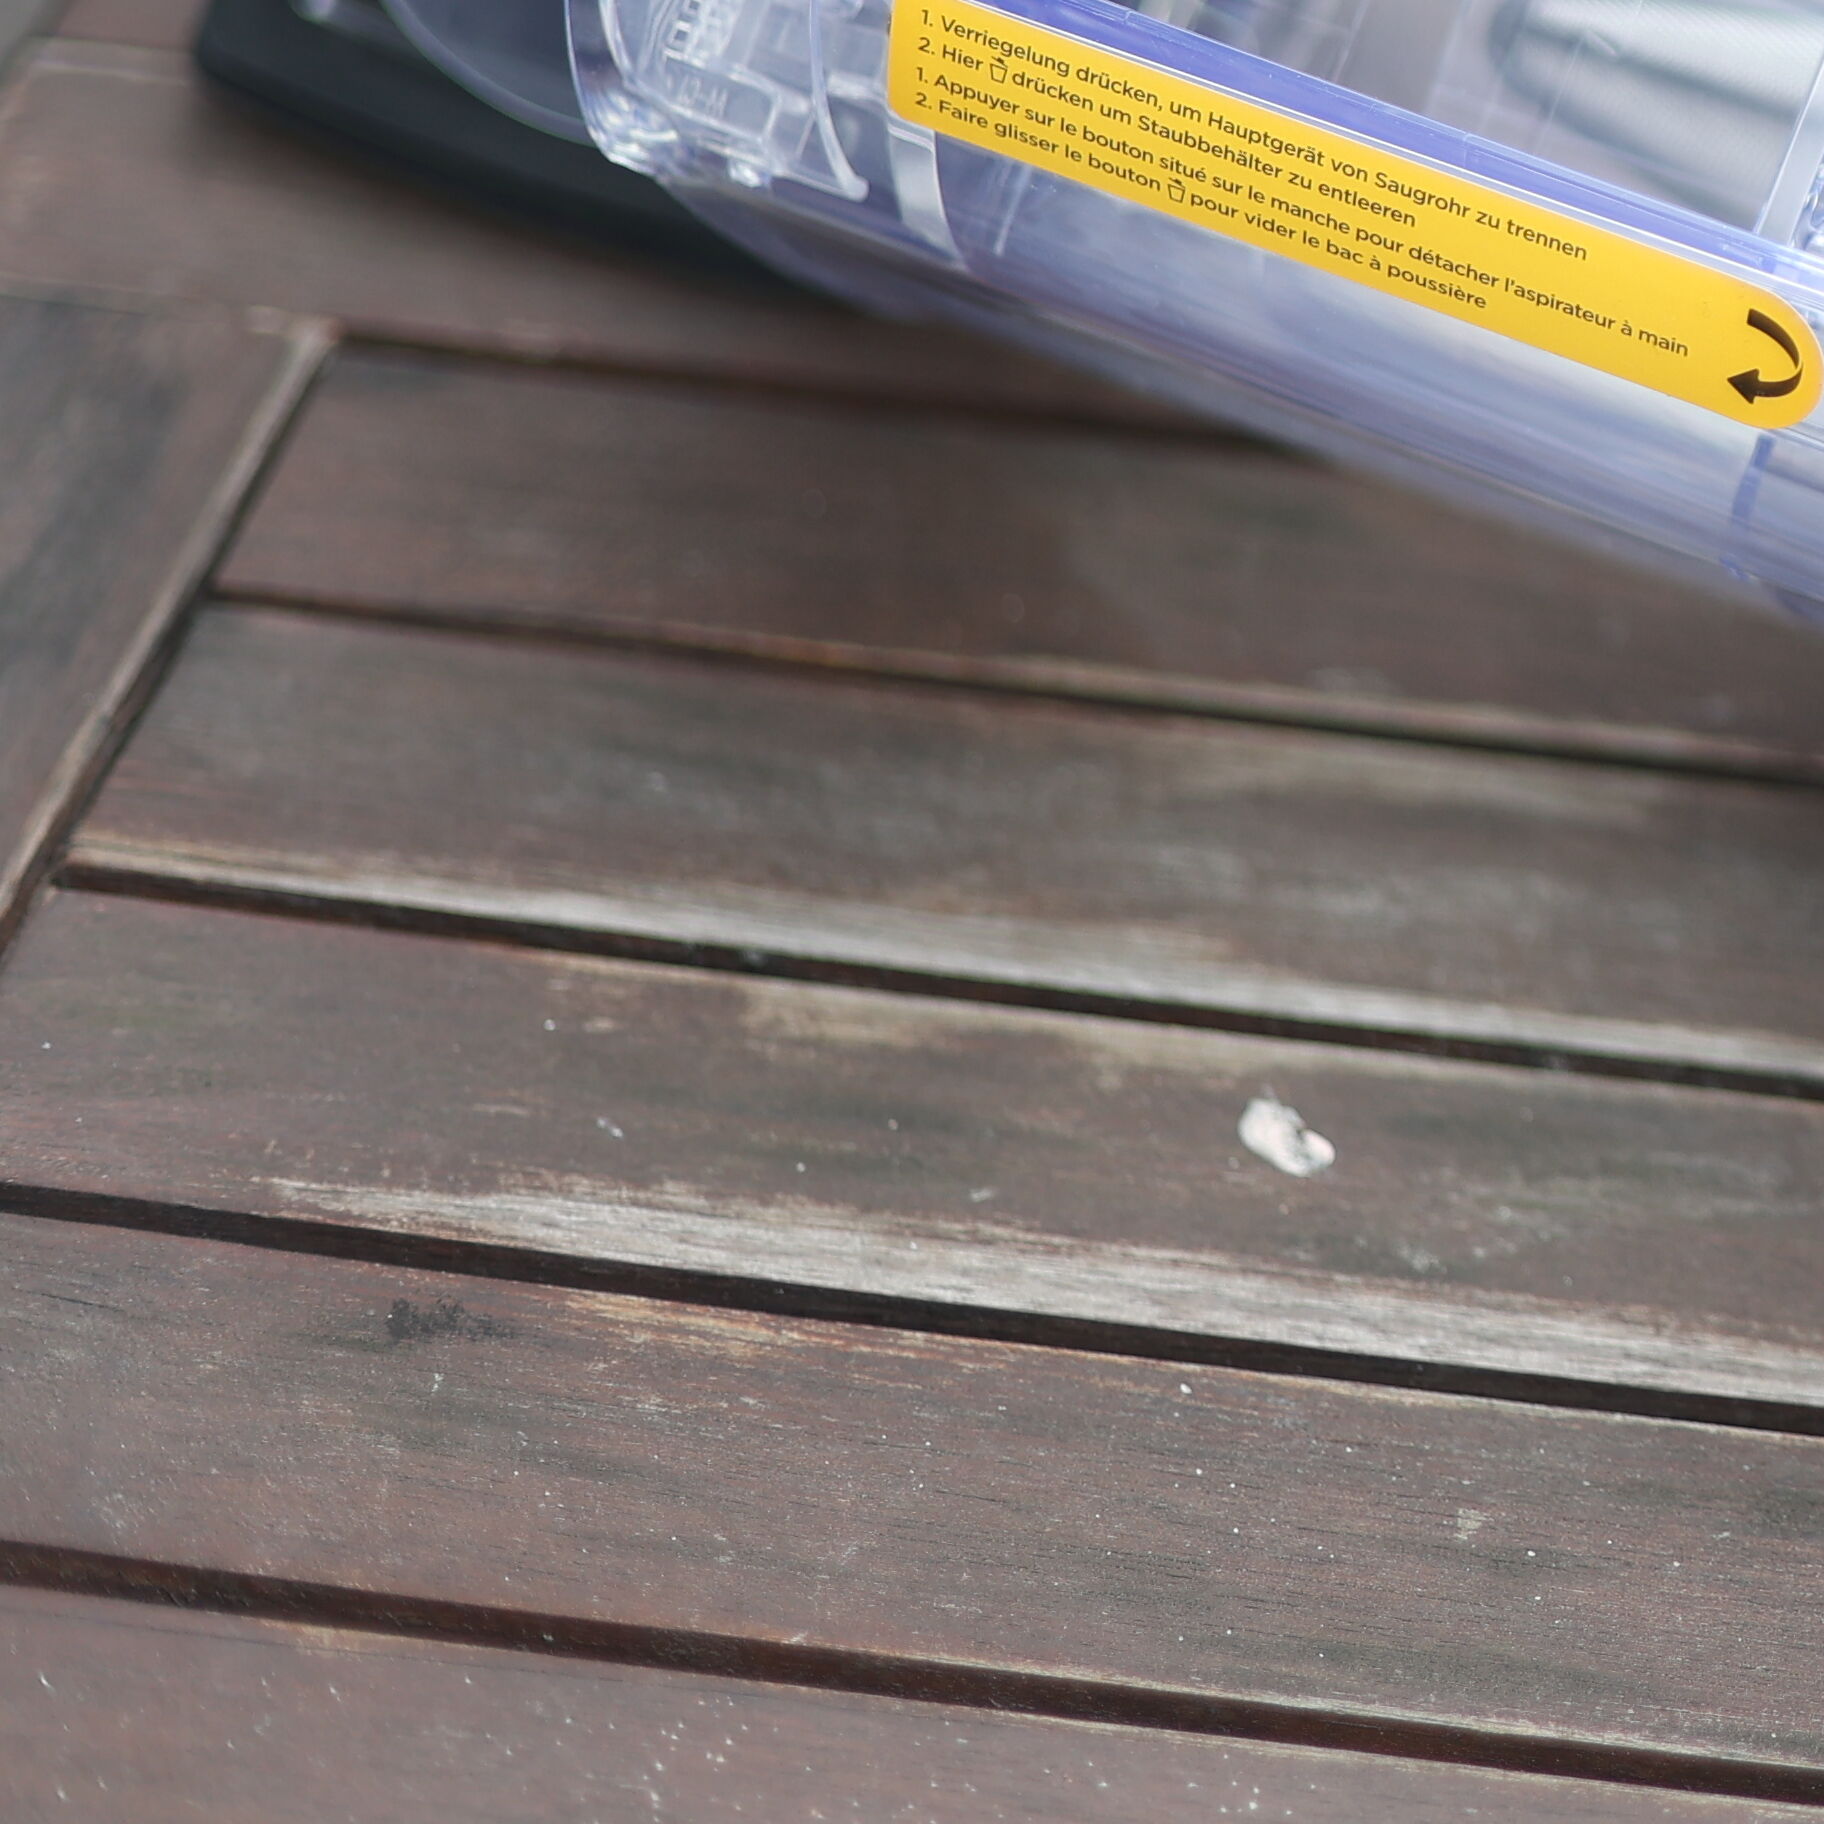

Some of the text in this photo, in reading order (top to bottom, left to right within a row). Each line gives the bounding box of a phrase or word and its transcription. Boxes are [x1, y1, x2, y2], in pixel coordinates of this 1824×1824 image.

[915, 92, 1487, 309] 2. Faire glisser le bouton pour vider le bac à poussière
[916, 66, 928, 84] 1.
[933, 74, 1021, 115] Appuyer
[1024, 108, 1056, 127] sur
[1060, 117, 1078, 136] le
[1082, 125, 1154, 164] bouton
[1159, 156, 1207, 183] situé
[1212, 176, 1244, 195] sur
[1248, 185, 1266, 204] le
[1270, 197, 1351, 235] manche
[1355, 227, 1404, 253] pour
[1408, 246, 1500, 288] détacher
[1620, 320, 1633, 337] à
[1638, 330, 1688, 357] main
[918, 36, 1416, 227] 2. Hier drücken um Staubbehälter zu entleeren
[922, 9, 1587, 261] 1. Verriegelung drücken, um Hauptgerät von Saugrohr zu trennen
